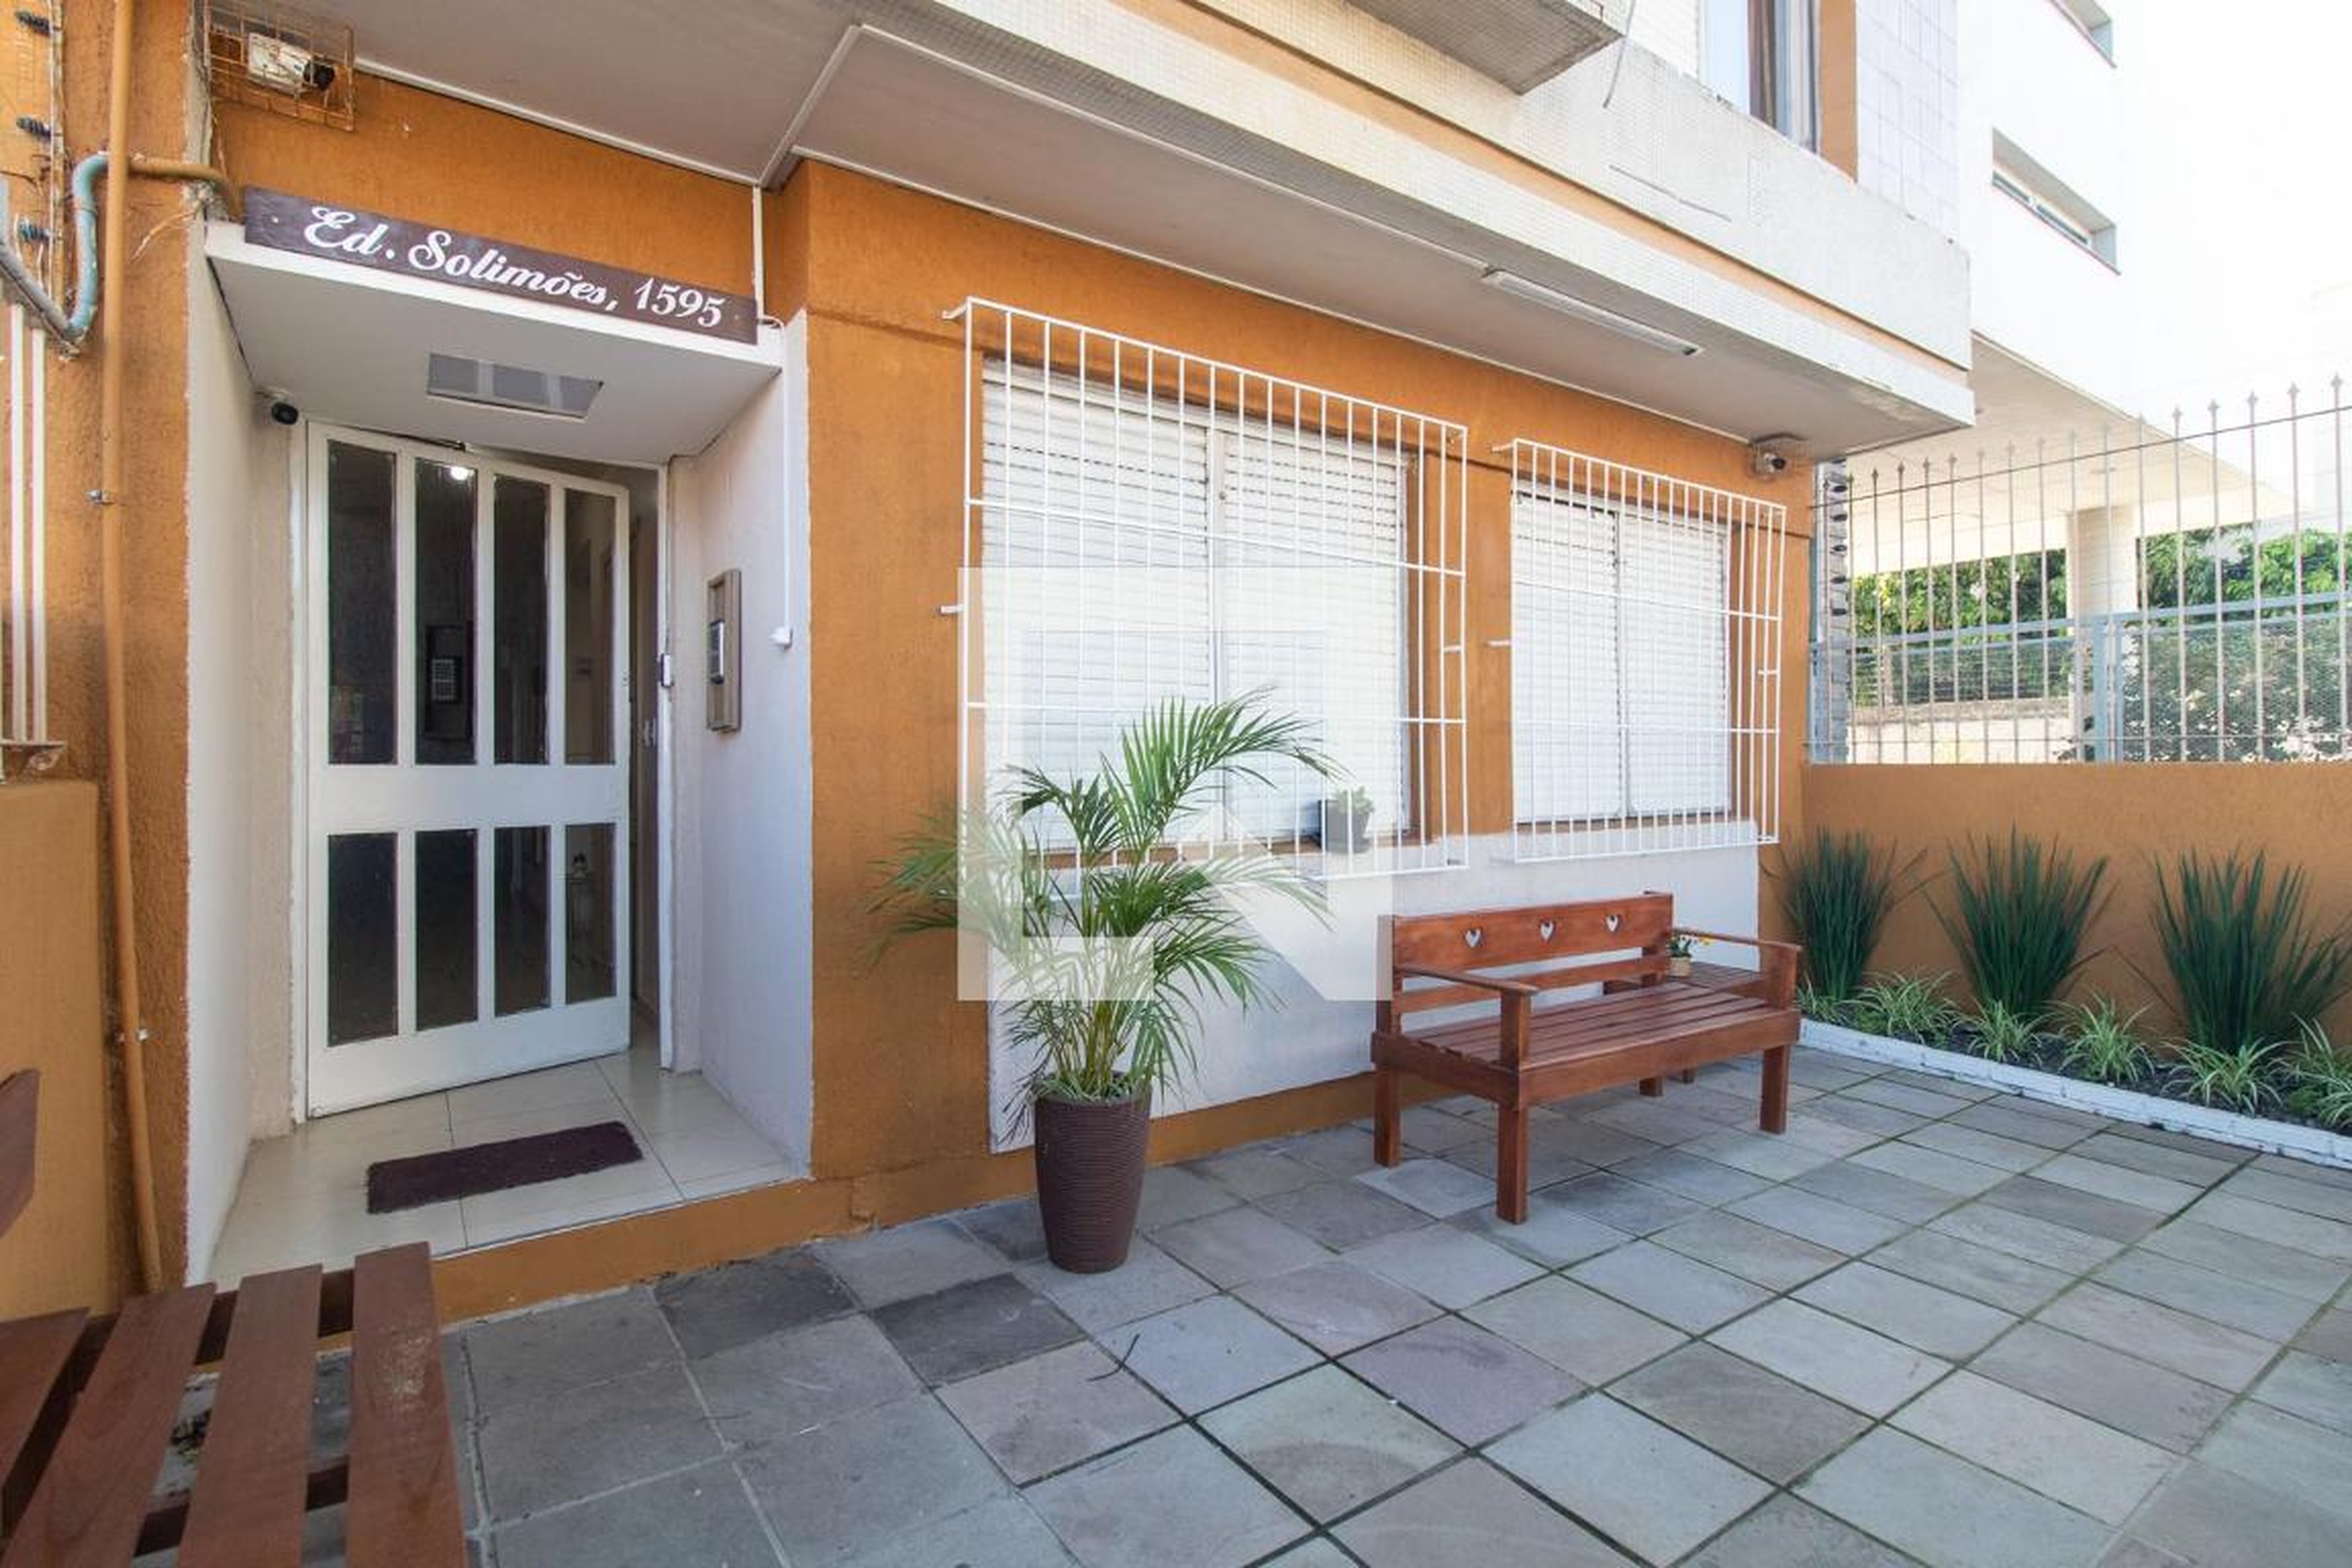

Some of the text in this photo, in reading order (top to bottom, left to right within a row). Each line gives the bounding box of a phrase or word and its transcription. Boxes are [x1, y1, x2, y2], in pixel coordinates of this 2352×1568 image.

[305, 207, 725, 328] Ed. Solimões, 1595
